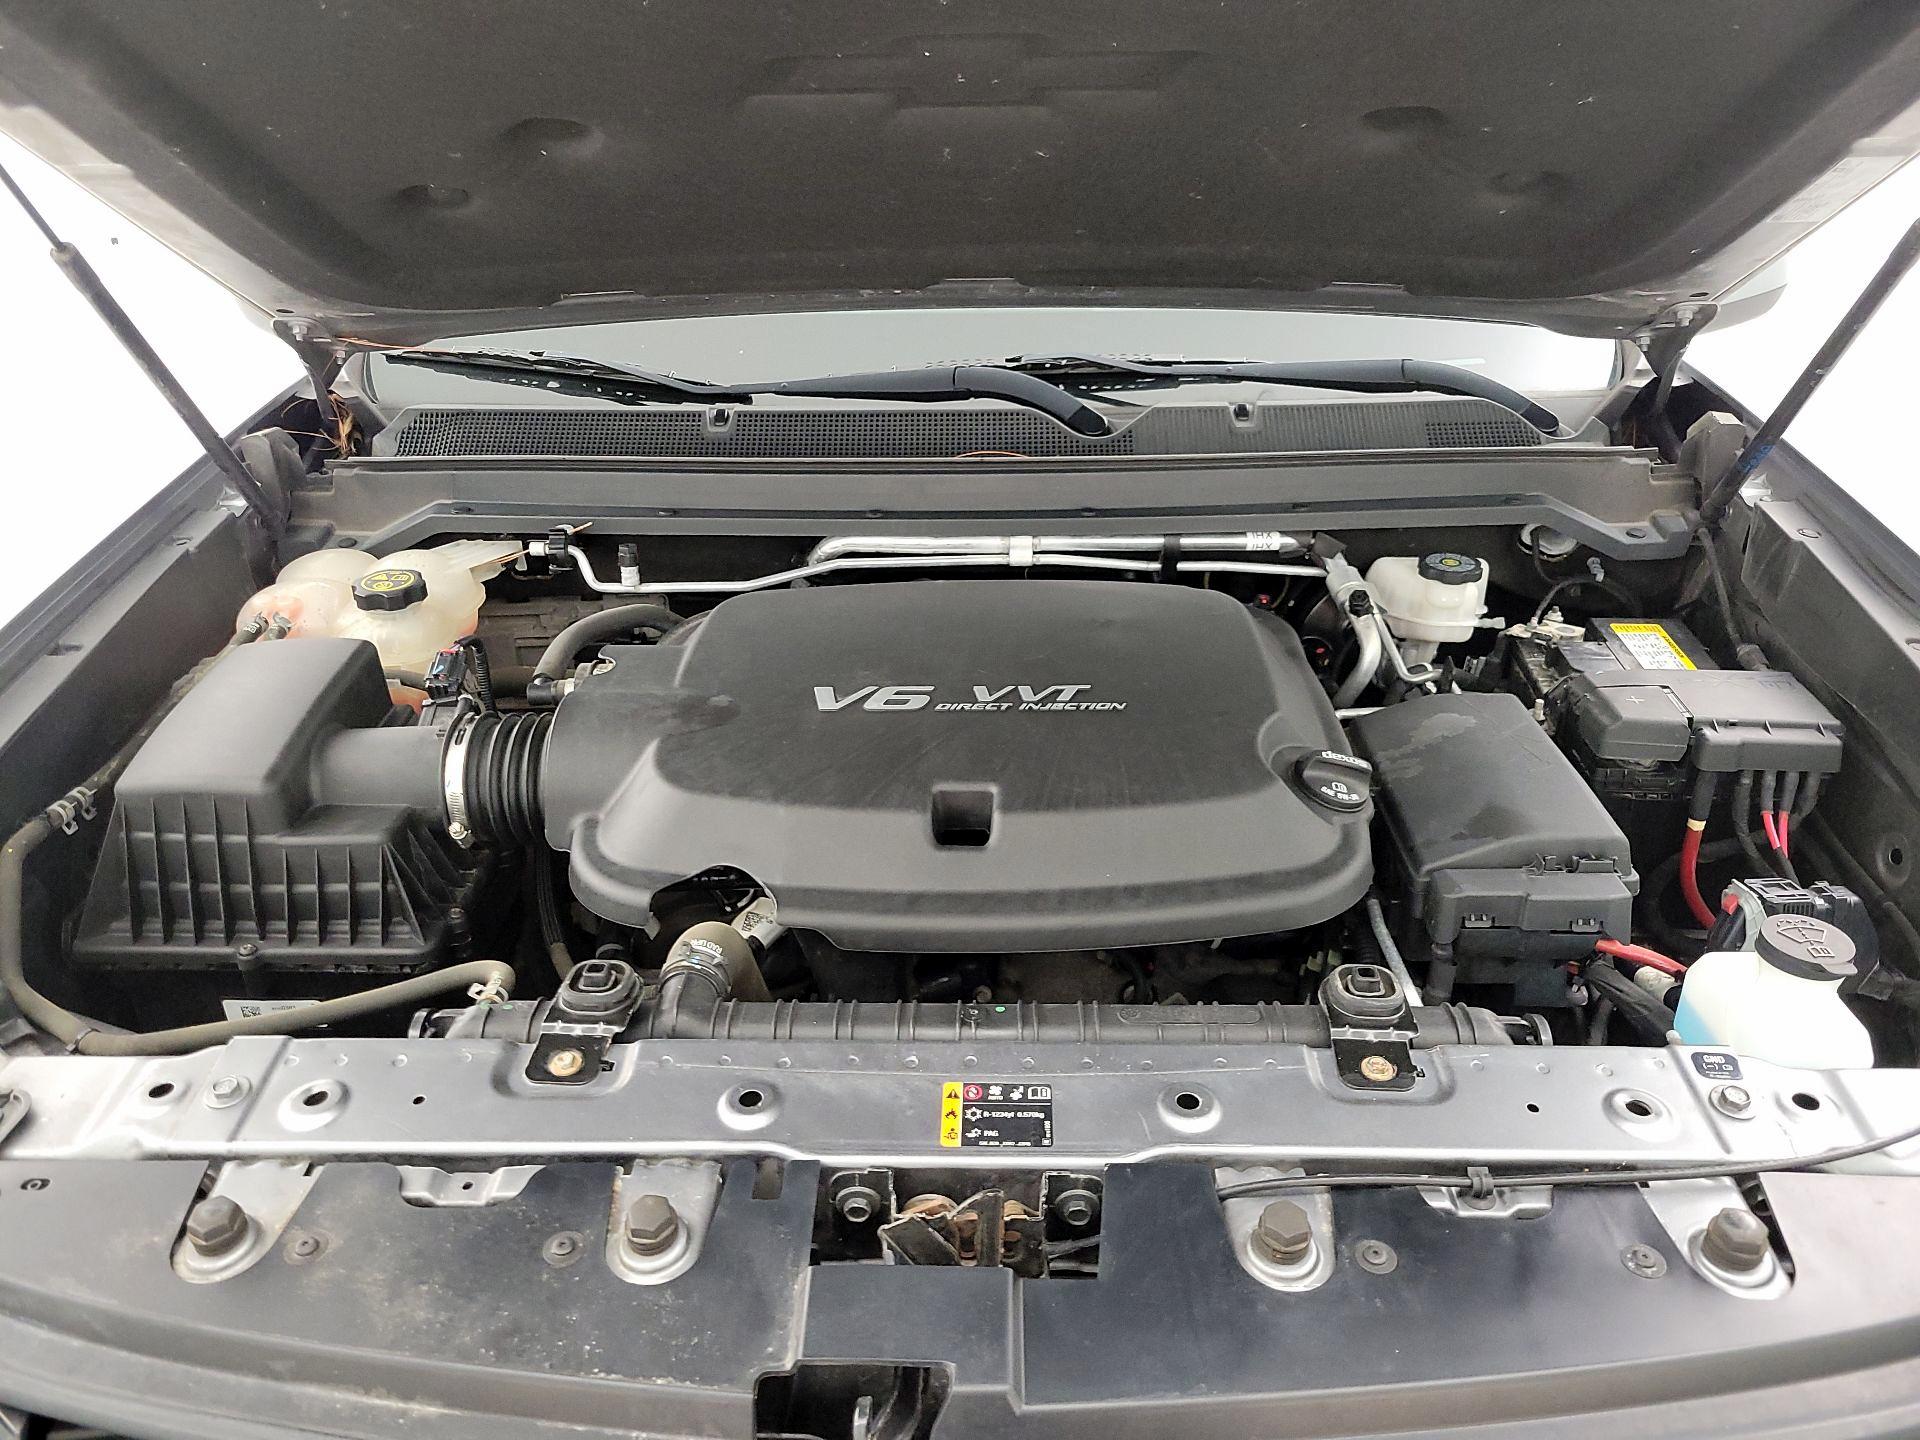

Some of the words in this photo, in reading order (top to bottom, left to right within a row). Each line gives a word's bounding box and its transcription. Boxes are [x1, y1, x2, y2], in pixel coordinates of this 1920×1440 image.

[813, 686, 935, 711] V6
[973, 685, 1092, 701] VVT
[935, 703, 1013, 711] DIRECT
[1018, 703, 1127, 711] INJECTION
[707, 941, 723, 954] RAD
[1703, 1055, 1726, 1063] GND
